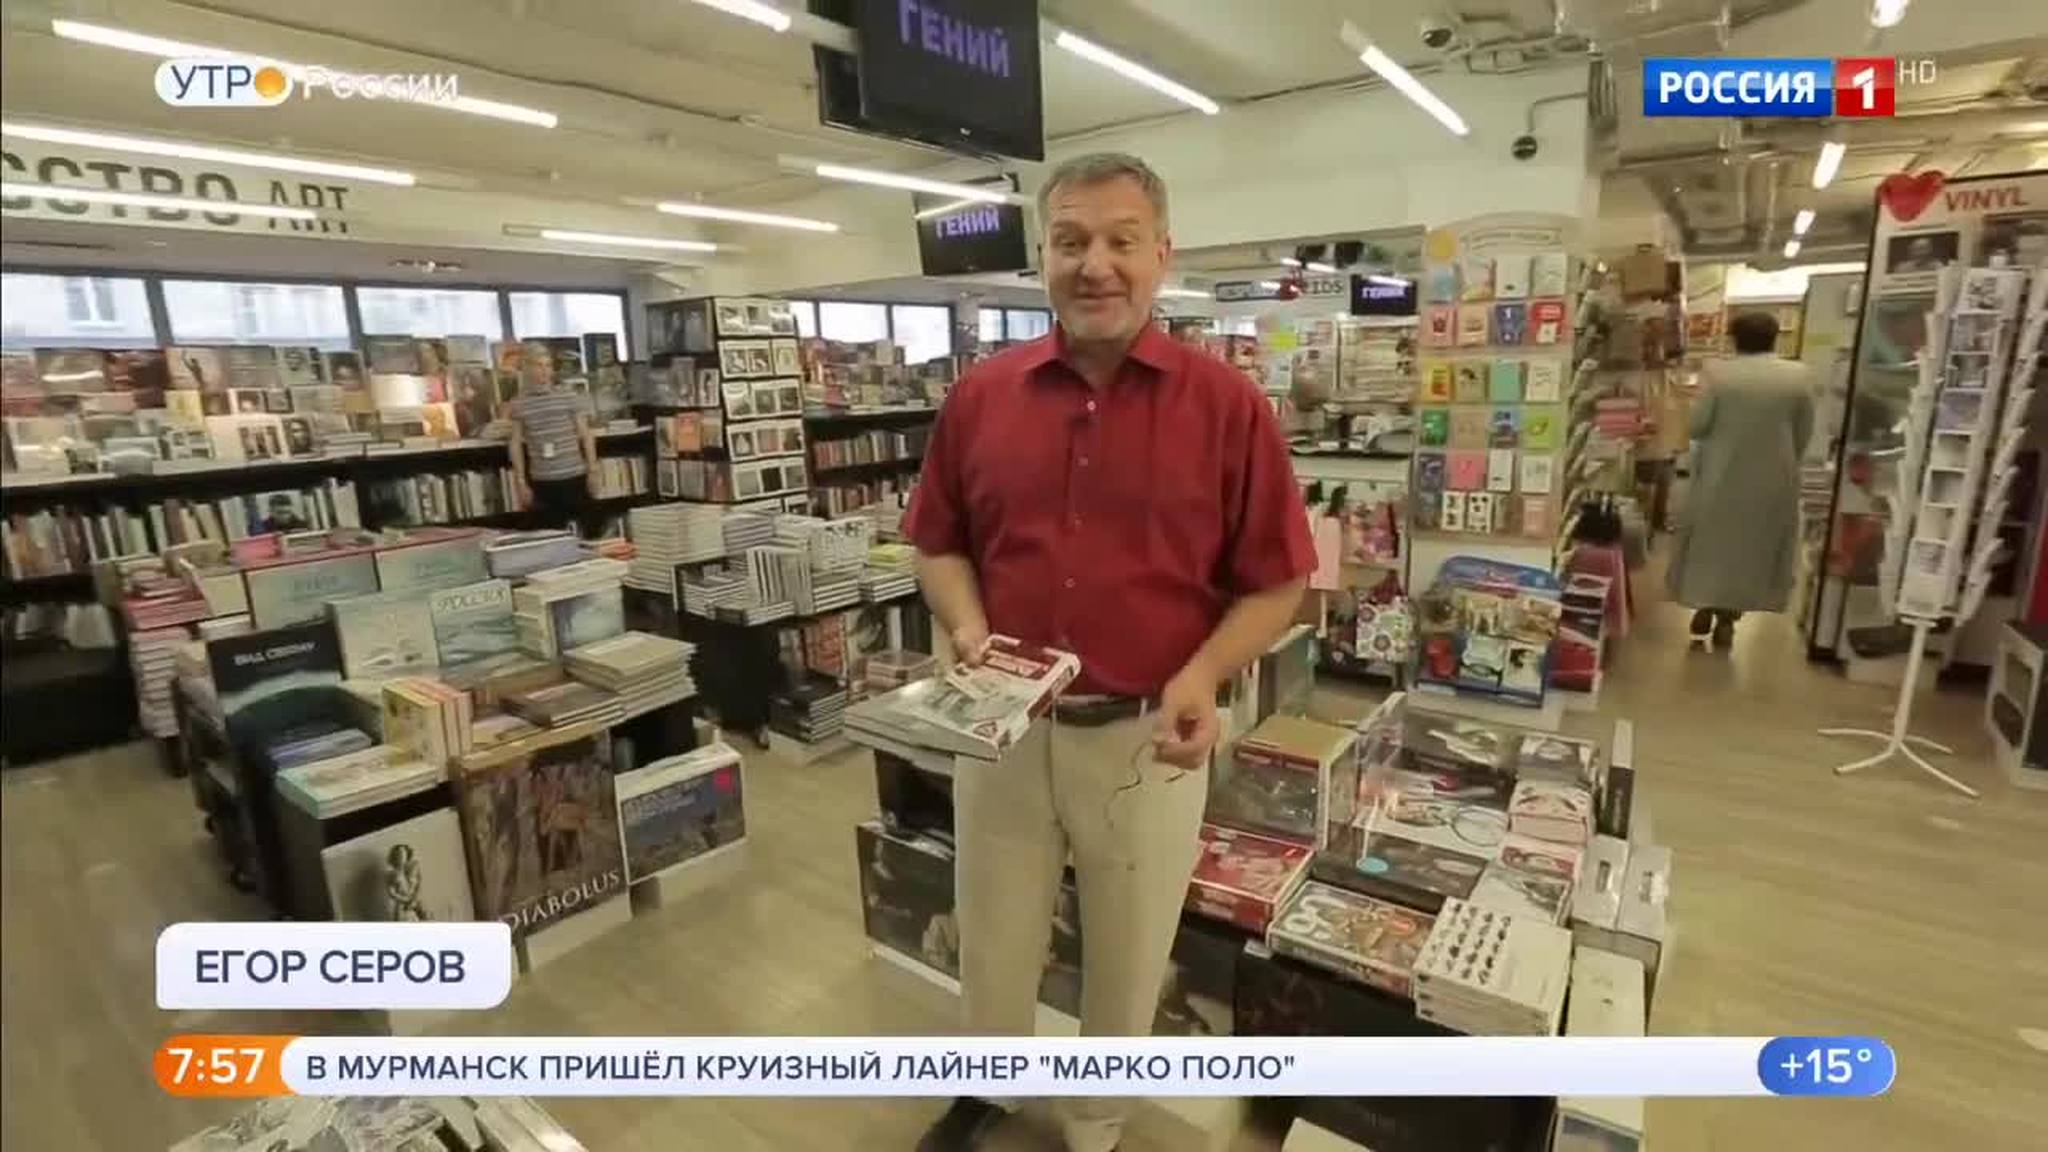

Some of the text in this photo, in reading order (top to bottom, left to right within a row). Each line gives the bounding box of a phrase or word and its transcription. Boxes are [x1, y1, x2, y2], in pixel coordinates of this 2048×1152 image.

[898, 0, 1009, 78] ГЕНИЙ
[268, 180, 348, 233] ART
[935, 204, 1000, 239] ГЕНИЙ
[1945, 187, 2029, 211] VINYL
[501, 868, 621, 932] DIABOLUS
